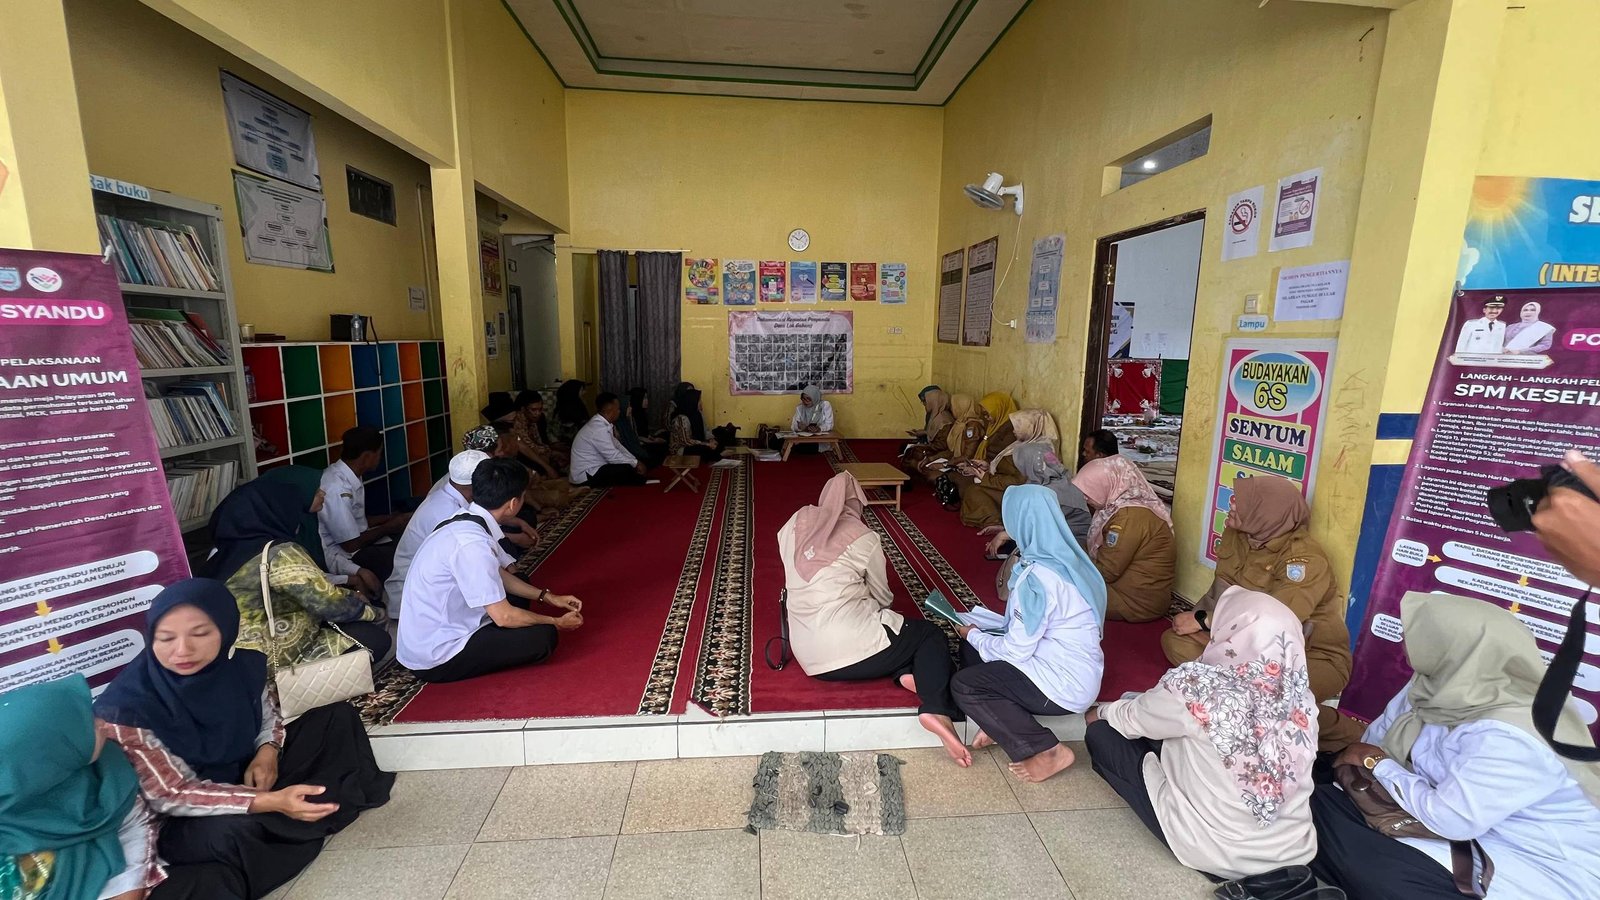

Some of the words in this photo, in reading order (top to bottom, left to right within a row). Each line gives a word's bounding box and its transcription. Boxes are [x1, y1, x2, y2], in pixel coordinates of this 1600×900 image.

[116, 180, 149, 199] buku
[1551, 264, 1600, 283] INTE
[1, 305, 105, 320] SYANDU
[1239, 319, 1265, 330] Lampu
[1, 356, 101, 366] PELAKSANAAN
[53, 371, 128, 387] UMUM
[1242, 362, 1309, 384] BUDAYAKAN
[1460, 373, 1512, 382] LANGKAH
[1520, 376, 1578, 385] LANGKAH
[55, 393, 97, 401] Pelayanan
[1254, 381, 1288, 411] 6S
[1454, 384, 1506, 399] SPM
[1509, 387, 1600, 406] KESEH
[23, 401, 75, 410] permohonan
[1441, 412, 1467, 420] Layanan
[1229, 418, 1307, 447] SENYUM
[24, 452, 61, 460] bersama
[62, 446, 109, 456] Pemerintah
[49, 454, 92, 465] kunjungan
[1232, 444, 1295, 474] SALAM
[1420, 464, 1446, 472] Layanan
[19, 478, 71, 490] mengajukan
[72, 473, 109, 483] dokumen
[110, 466, 157, 478] permohonan
[22, 473, 61, 483] lapangan
[58, 494, 109, 507] permohonan
[110, 490, 129, 499] yang
[35, 518, 83, 532] Pemerintah
[1465, 516, 1497, 527] Posyandu
[34, 570, 88, 587] POSYANDU
[90, 560, 126, 574] MENUJU
[38, 575, 96, 594] PEKERJAAN
[98, 568, 125, 579] UMUM
[44, 610, 90, 626] MENDATA
[91, 596, 135, 613] PEMOHON
[25, 621, 73, 640] TENTANG
[74, 606, 128, 626] PEKERJAAN
[10, 658, 66, 679] MELAKUKAN
[66, 644, 110, 661] VERIFIKASI
[110, 637, 129, 647] DATA
[53, 654, 98, 673] LAPANGAN
[99, 642, 135, 657] BERSAMA
